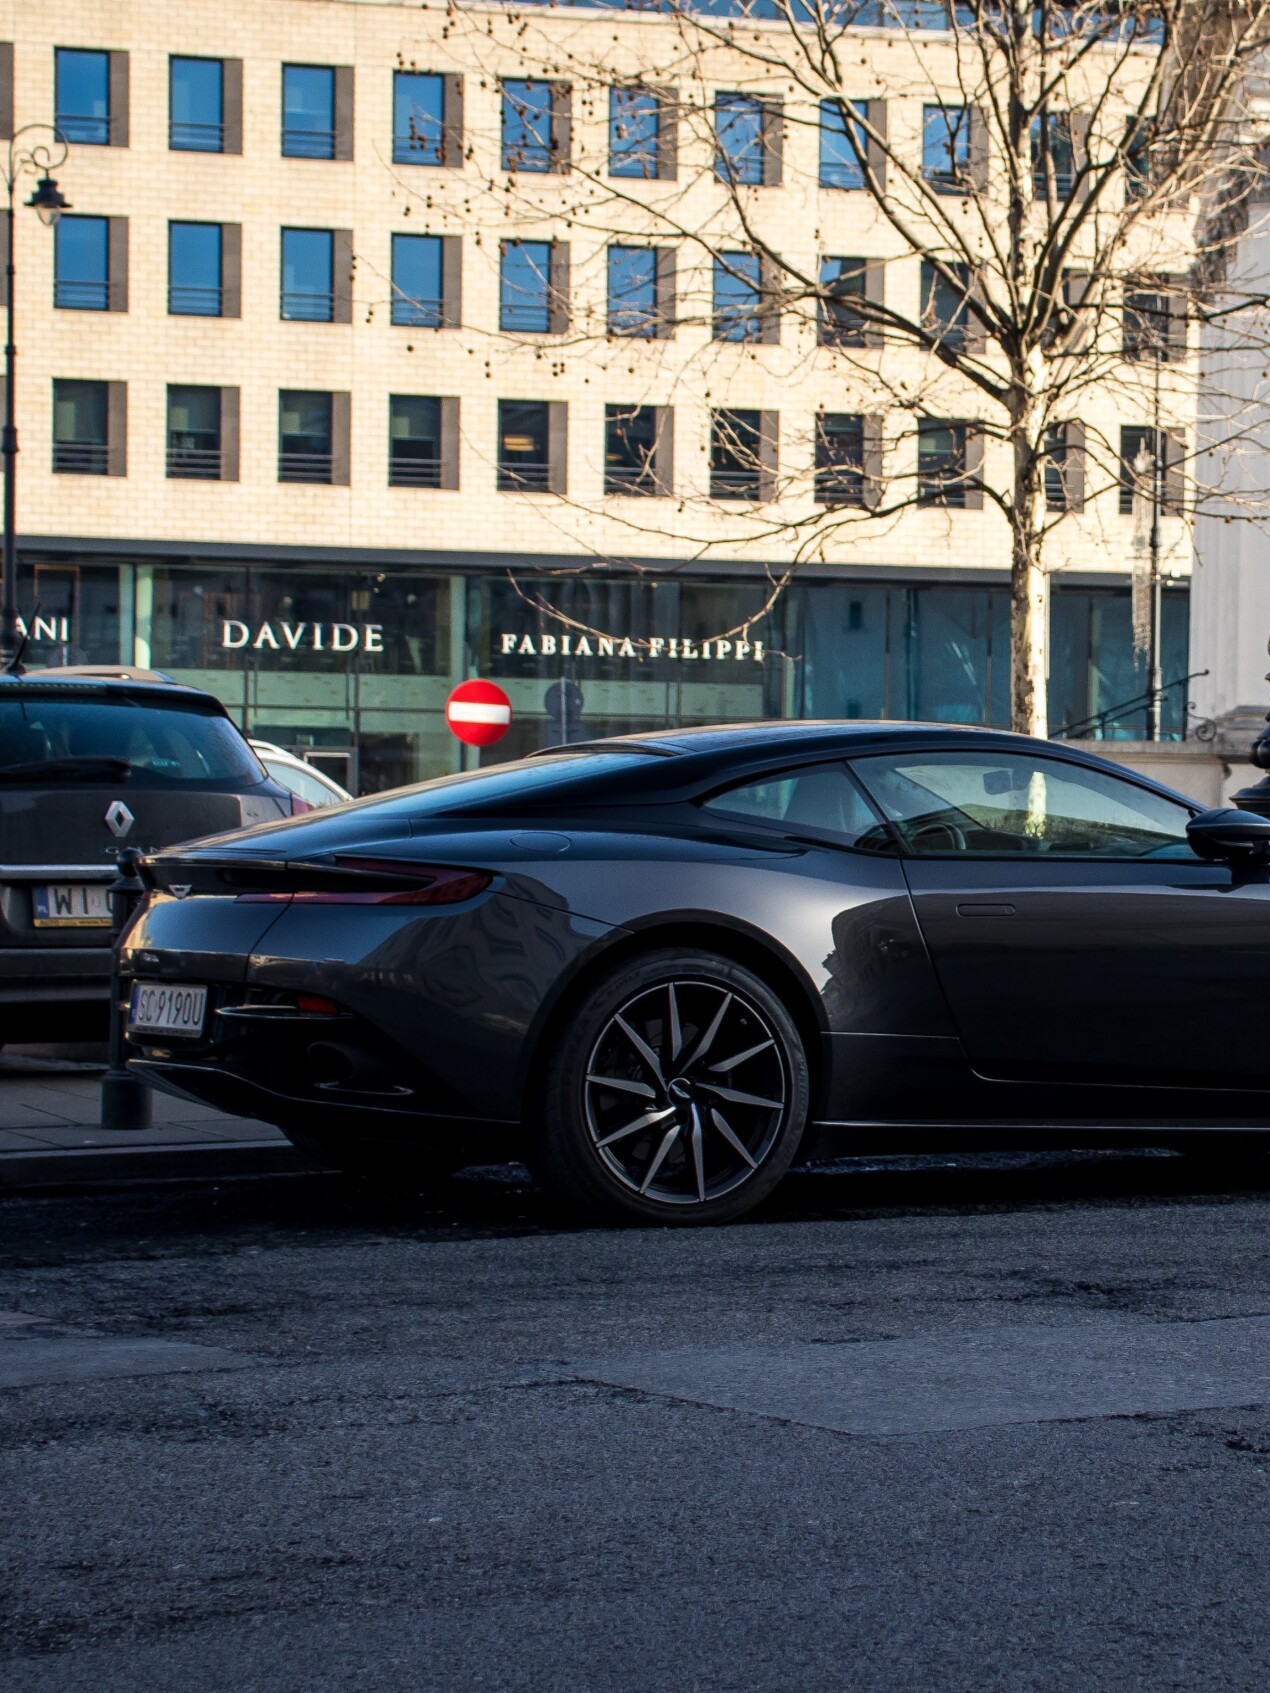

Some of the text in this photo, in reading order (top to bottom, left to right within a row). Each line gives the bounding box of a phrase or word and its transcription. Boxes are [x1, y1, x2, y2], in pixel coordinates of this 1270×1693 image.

[221, 619, 384, 652] DAVIDE
[501, 633, 766, 661] FABIANA FILIPPI
